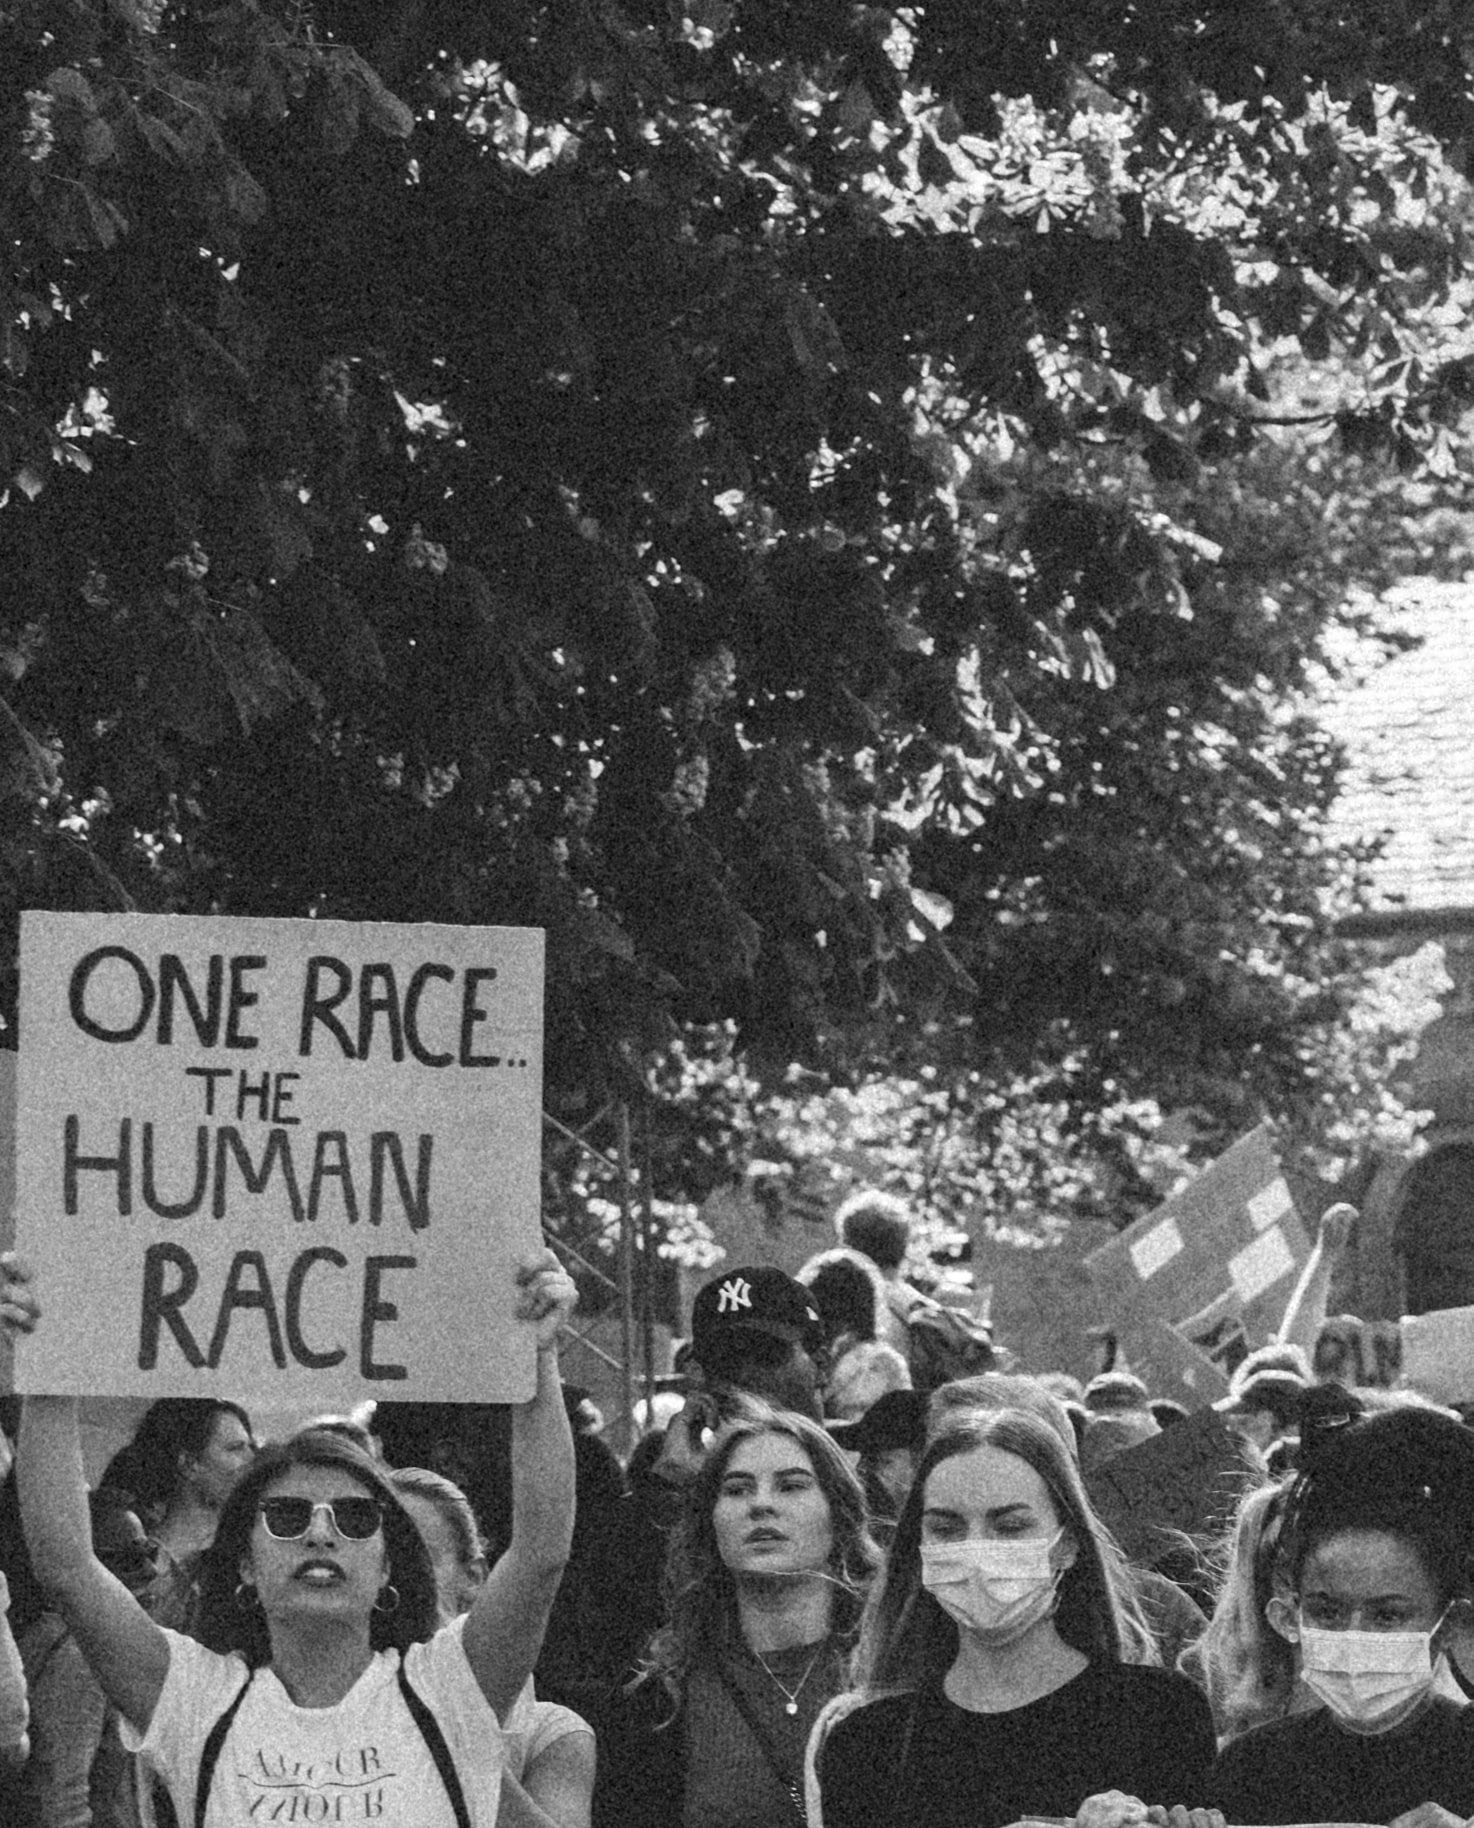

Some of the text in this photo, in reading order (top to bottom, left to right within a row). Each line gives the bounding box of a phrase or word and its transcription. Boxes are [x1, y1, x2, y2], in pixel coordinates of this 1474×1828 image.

[68, 946, 268, 1049] ONE
[186, 1066, 301, 1125] THE
[64, 1114, 434, 1234] HUMAN
[138, 1241, 418, 1382] RACE
[717, 1277, 752, 1313] NY
